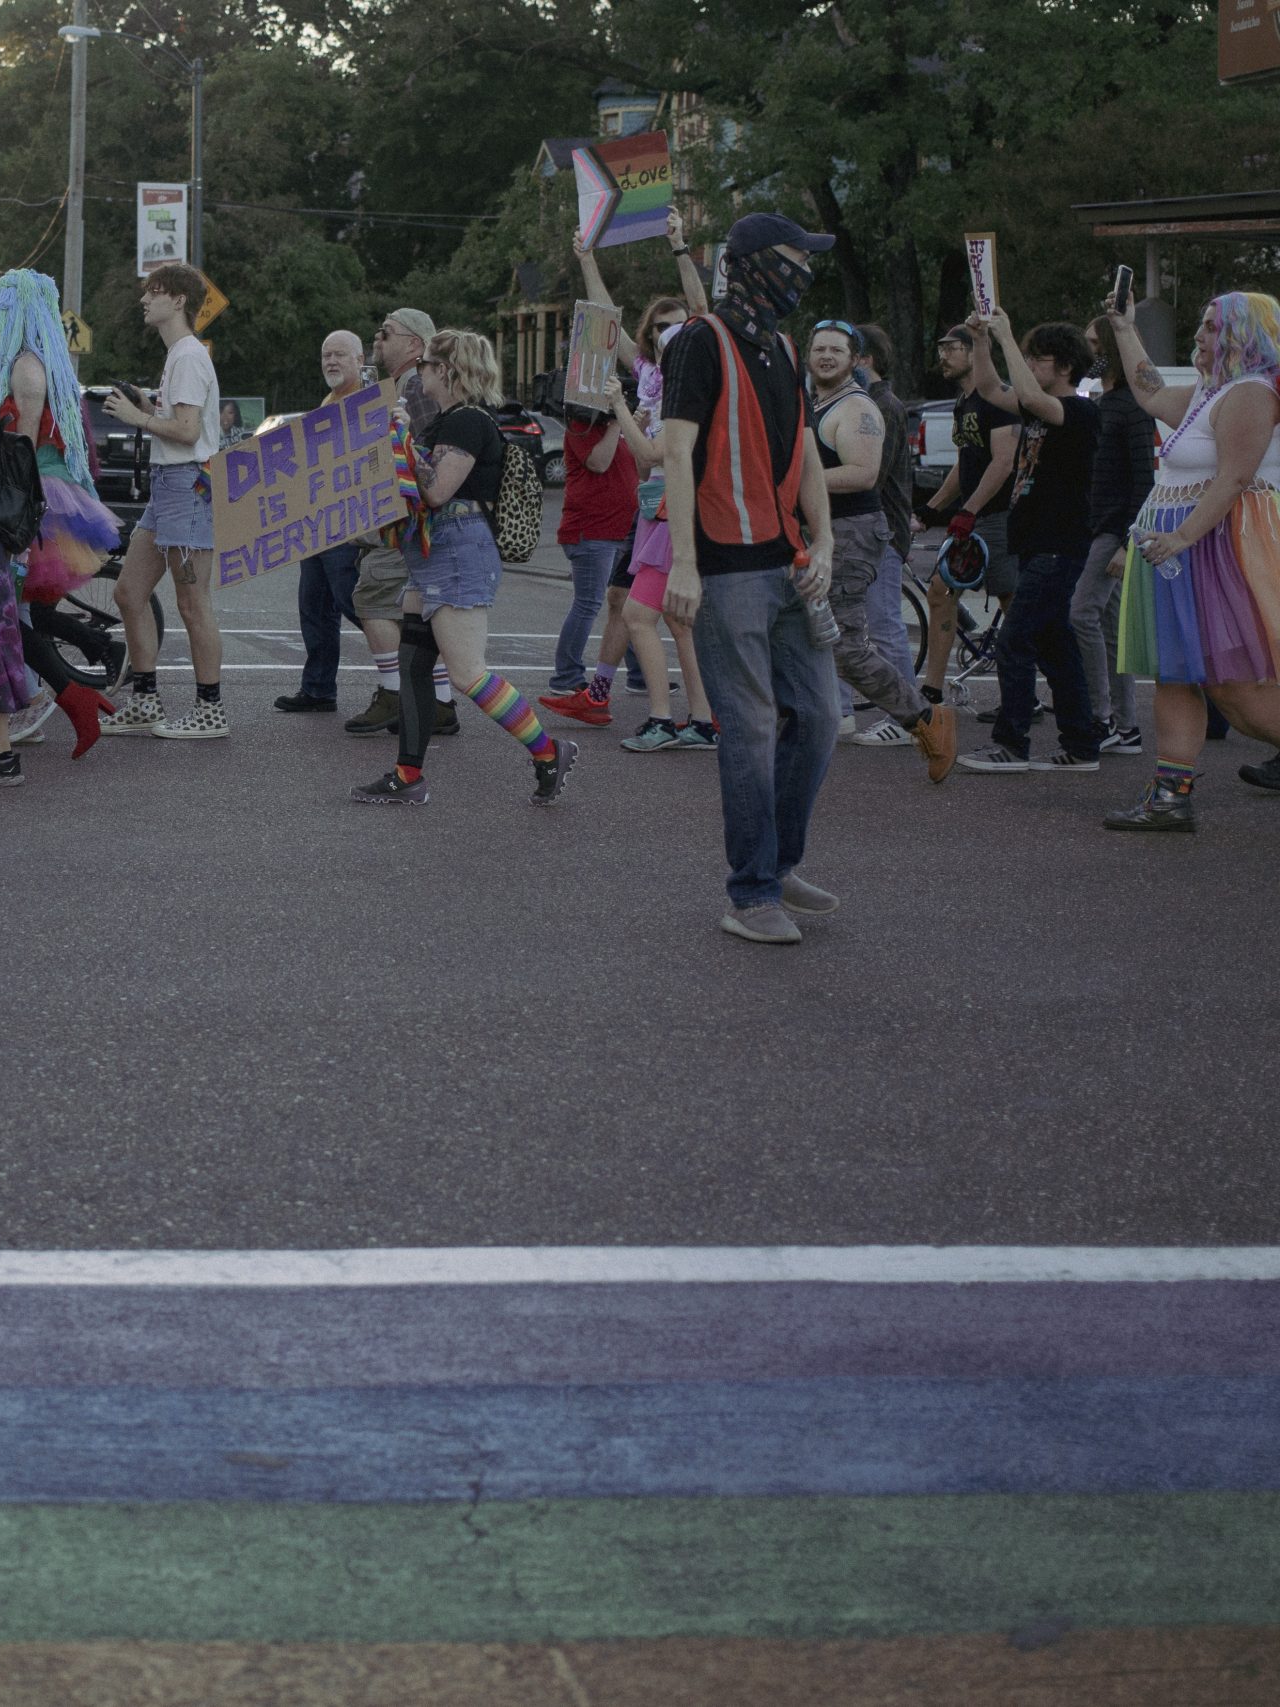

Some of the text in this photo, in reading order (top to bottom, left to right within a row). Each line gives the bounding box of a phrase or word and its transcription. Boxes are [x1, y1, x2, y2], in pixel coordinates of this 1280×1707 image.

[618, 163, 668, 190] Love
[573, 311, 618, 351] PROUD
[226, 384, 390, 503] DRAG
[219, 477, 398, 586] EVERYONE
